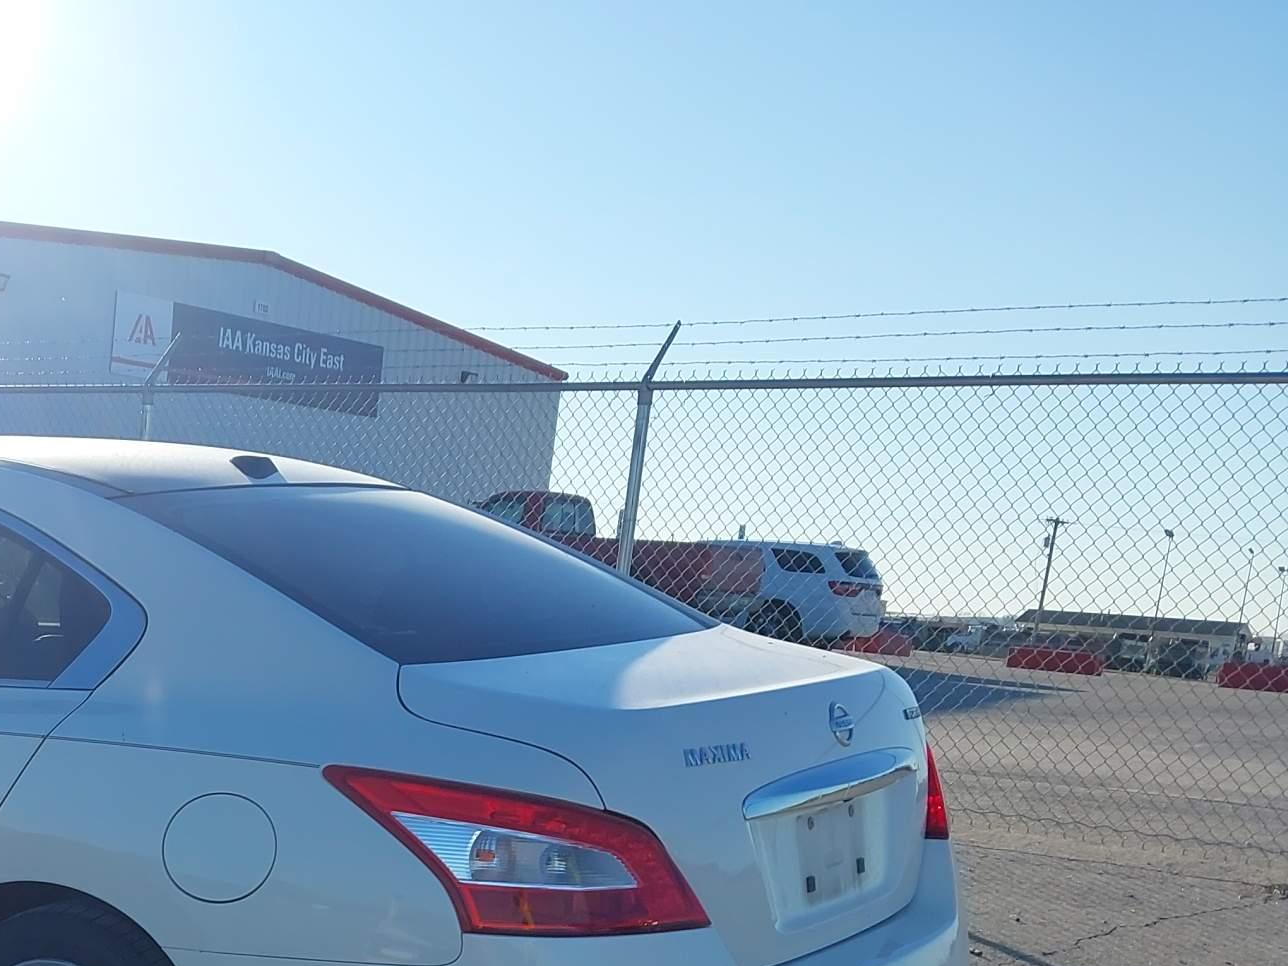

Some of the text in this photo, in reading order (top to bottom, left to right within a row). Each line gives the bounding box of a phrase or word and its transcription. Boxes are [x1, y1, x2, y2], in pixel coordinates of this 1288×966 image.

[219, 327, 345, 372] IAA Kansas City East
[682, 743, 752, 768] MAXIMA
